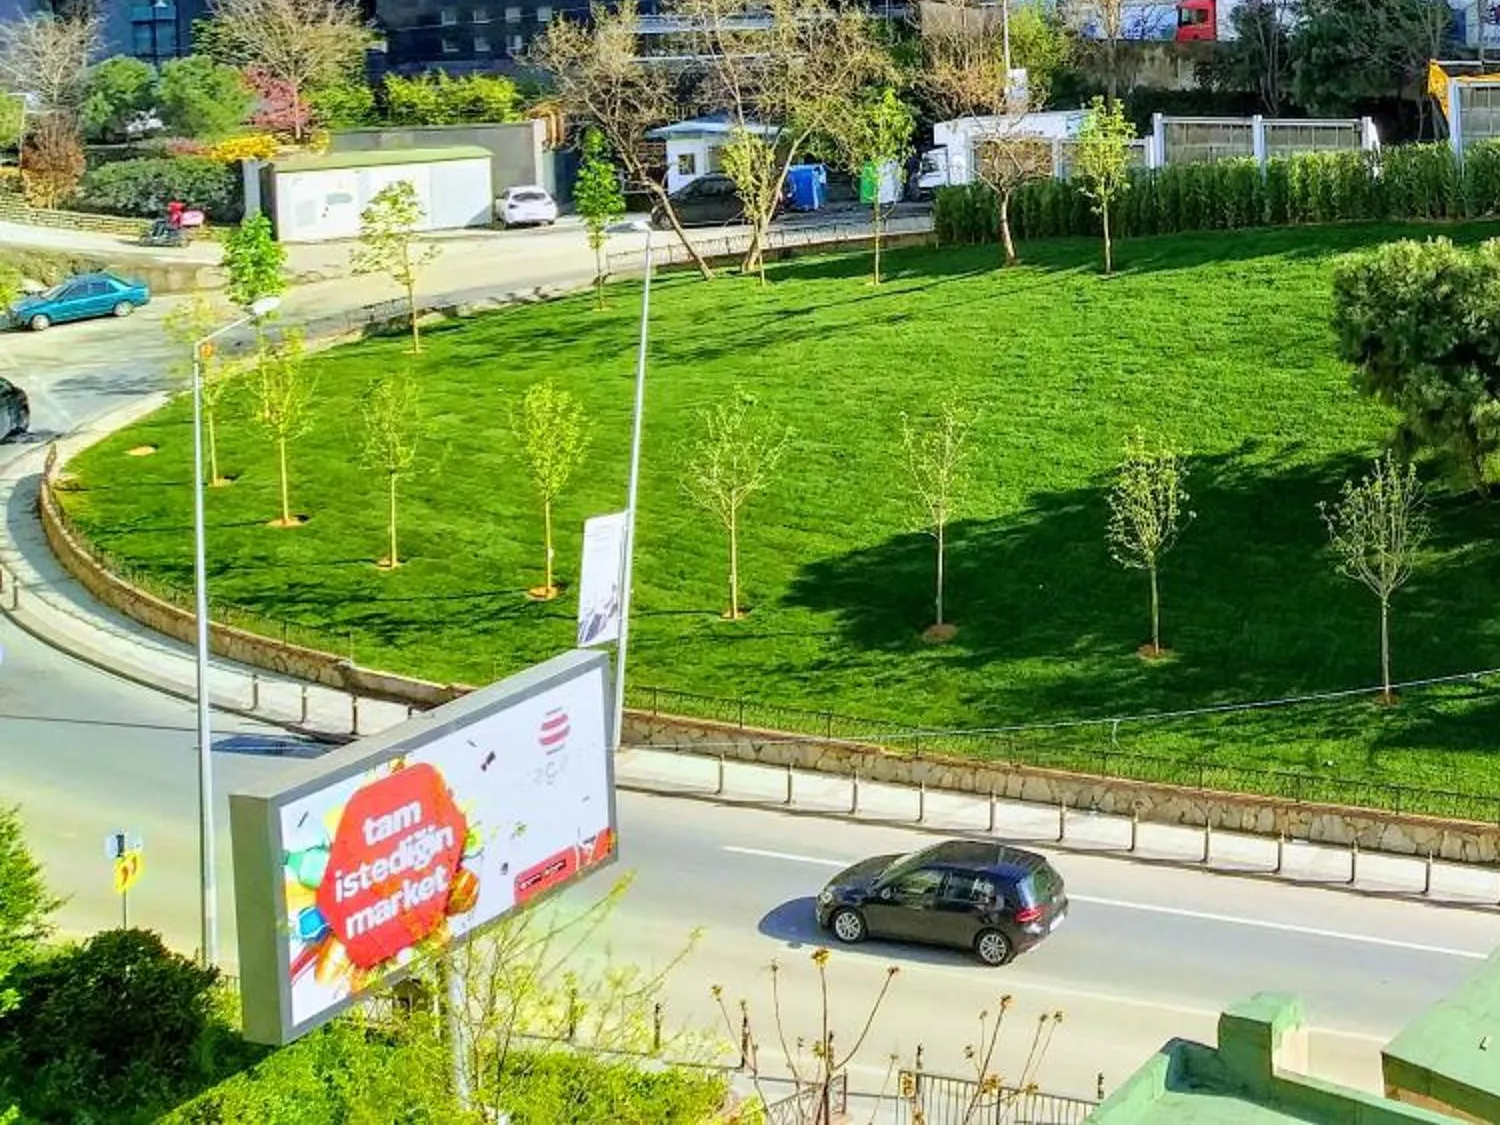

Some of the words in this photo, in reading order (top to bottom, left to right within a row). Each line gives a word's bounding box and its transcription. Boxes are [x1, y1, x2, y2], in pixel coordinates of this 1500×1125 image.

[363, 801, 422, 846] tam
[335, 825, 454, 903] istediğin
[346, 864, 449, 939] market
